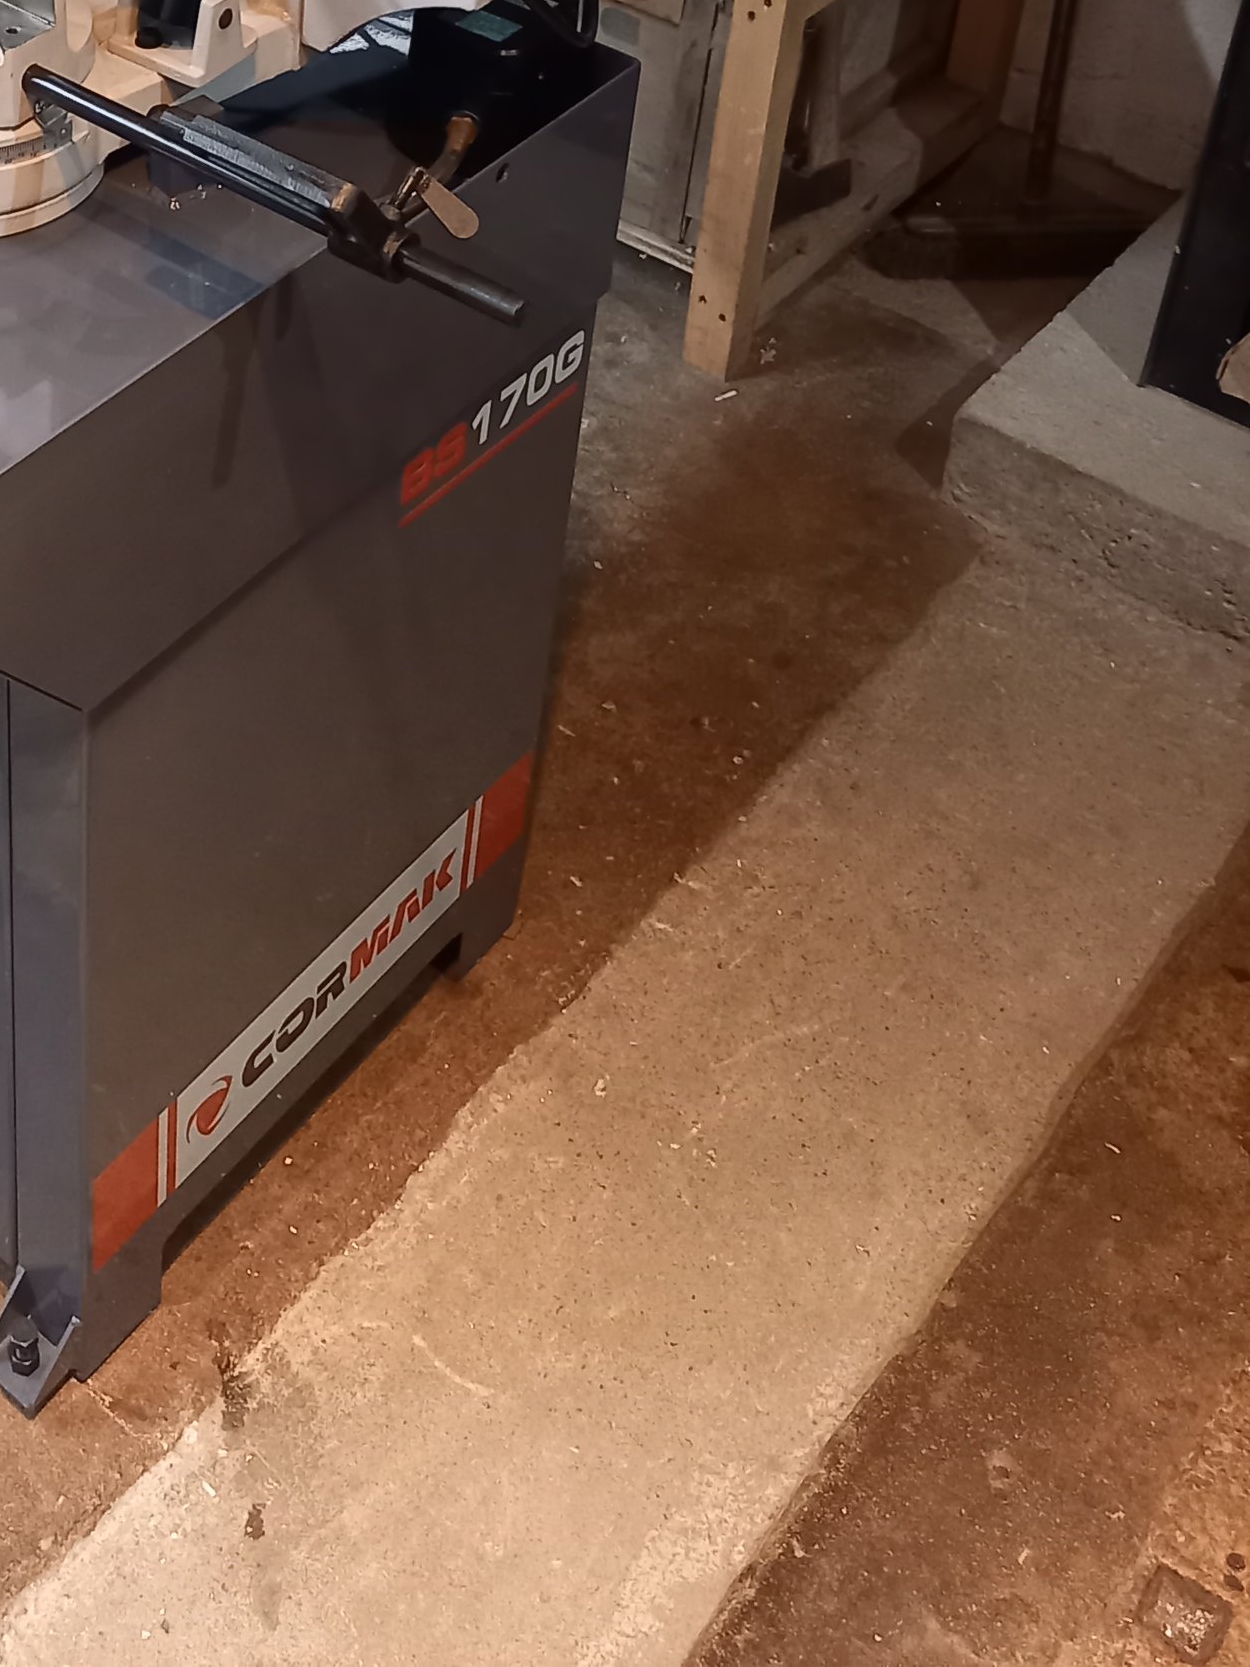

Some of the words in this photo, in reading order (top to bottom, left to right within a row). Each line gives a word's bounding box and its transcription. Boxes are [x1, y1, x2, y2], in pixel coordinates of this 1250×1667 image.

[401, 421, 468, 505] BS
[471, 330, 585, 445] 170G
[241, 848, 457, 1088] CORMAK
